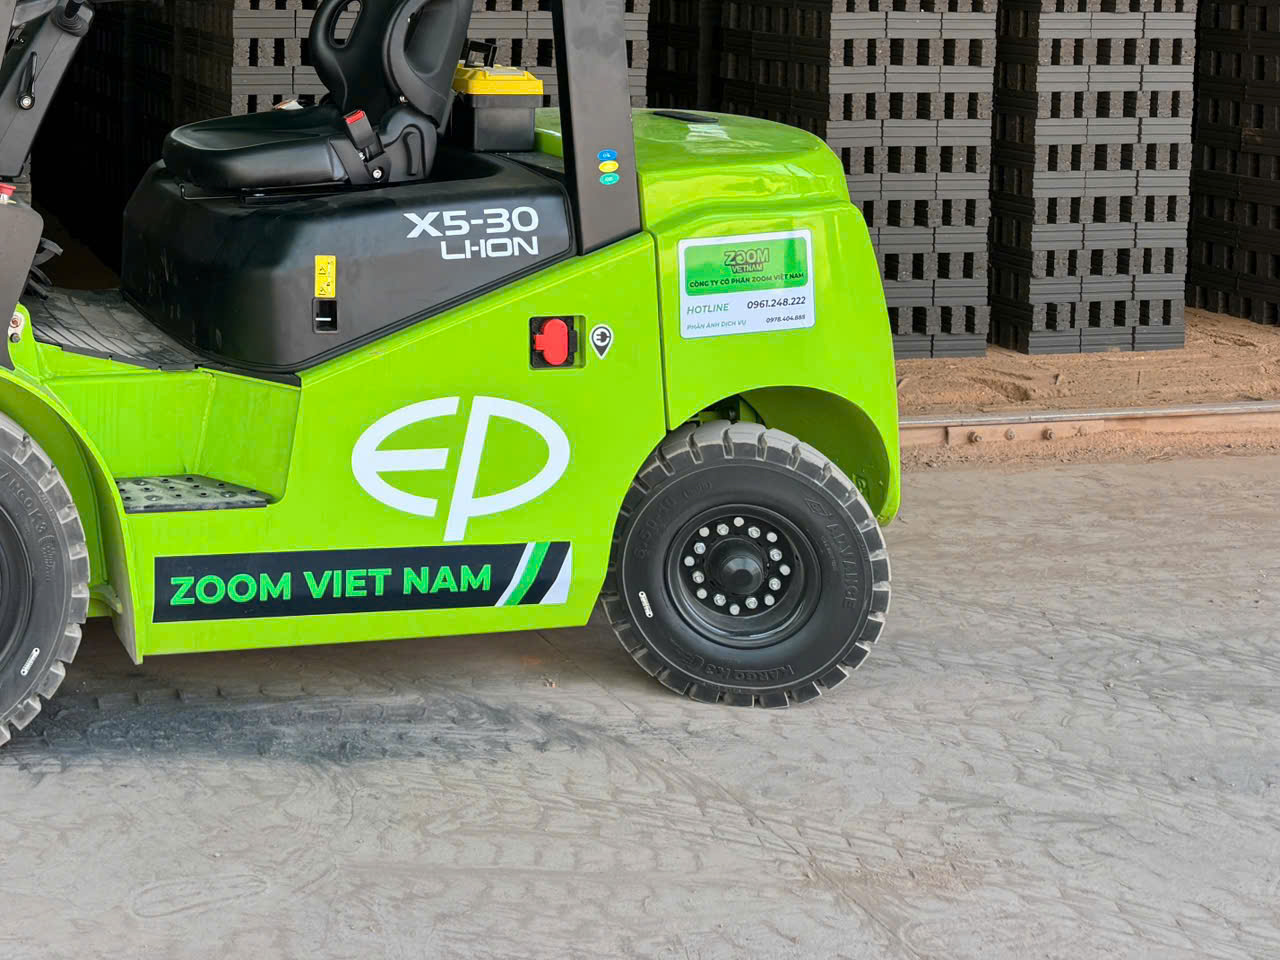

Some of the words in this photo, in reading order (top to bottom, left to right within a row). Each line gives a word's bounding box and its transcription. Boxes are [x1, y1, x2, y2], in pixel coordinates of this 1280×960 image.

[402, 206, 539, 239] X5-30
[440, 235, 539, 260] LI-ION
[724, 248, 770, 266] ZOOM
[751, 275, 772, 283] ZOOM
[789, 272, 804, 280] NAM
[687, 303, 729, 315] HOTLINE
[747, 296, 806, 310] 0961.248.222
[351, 396, 571, 542] EP
[169, 571, 293, 607] ZOOM
[303, 567, 393, 598] VIET
[402, 563, 493, 595] NAM
